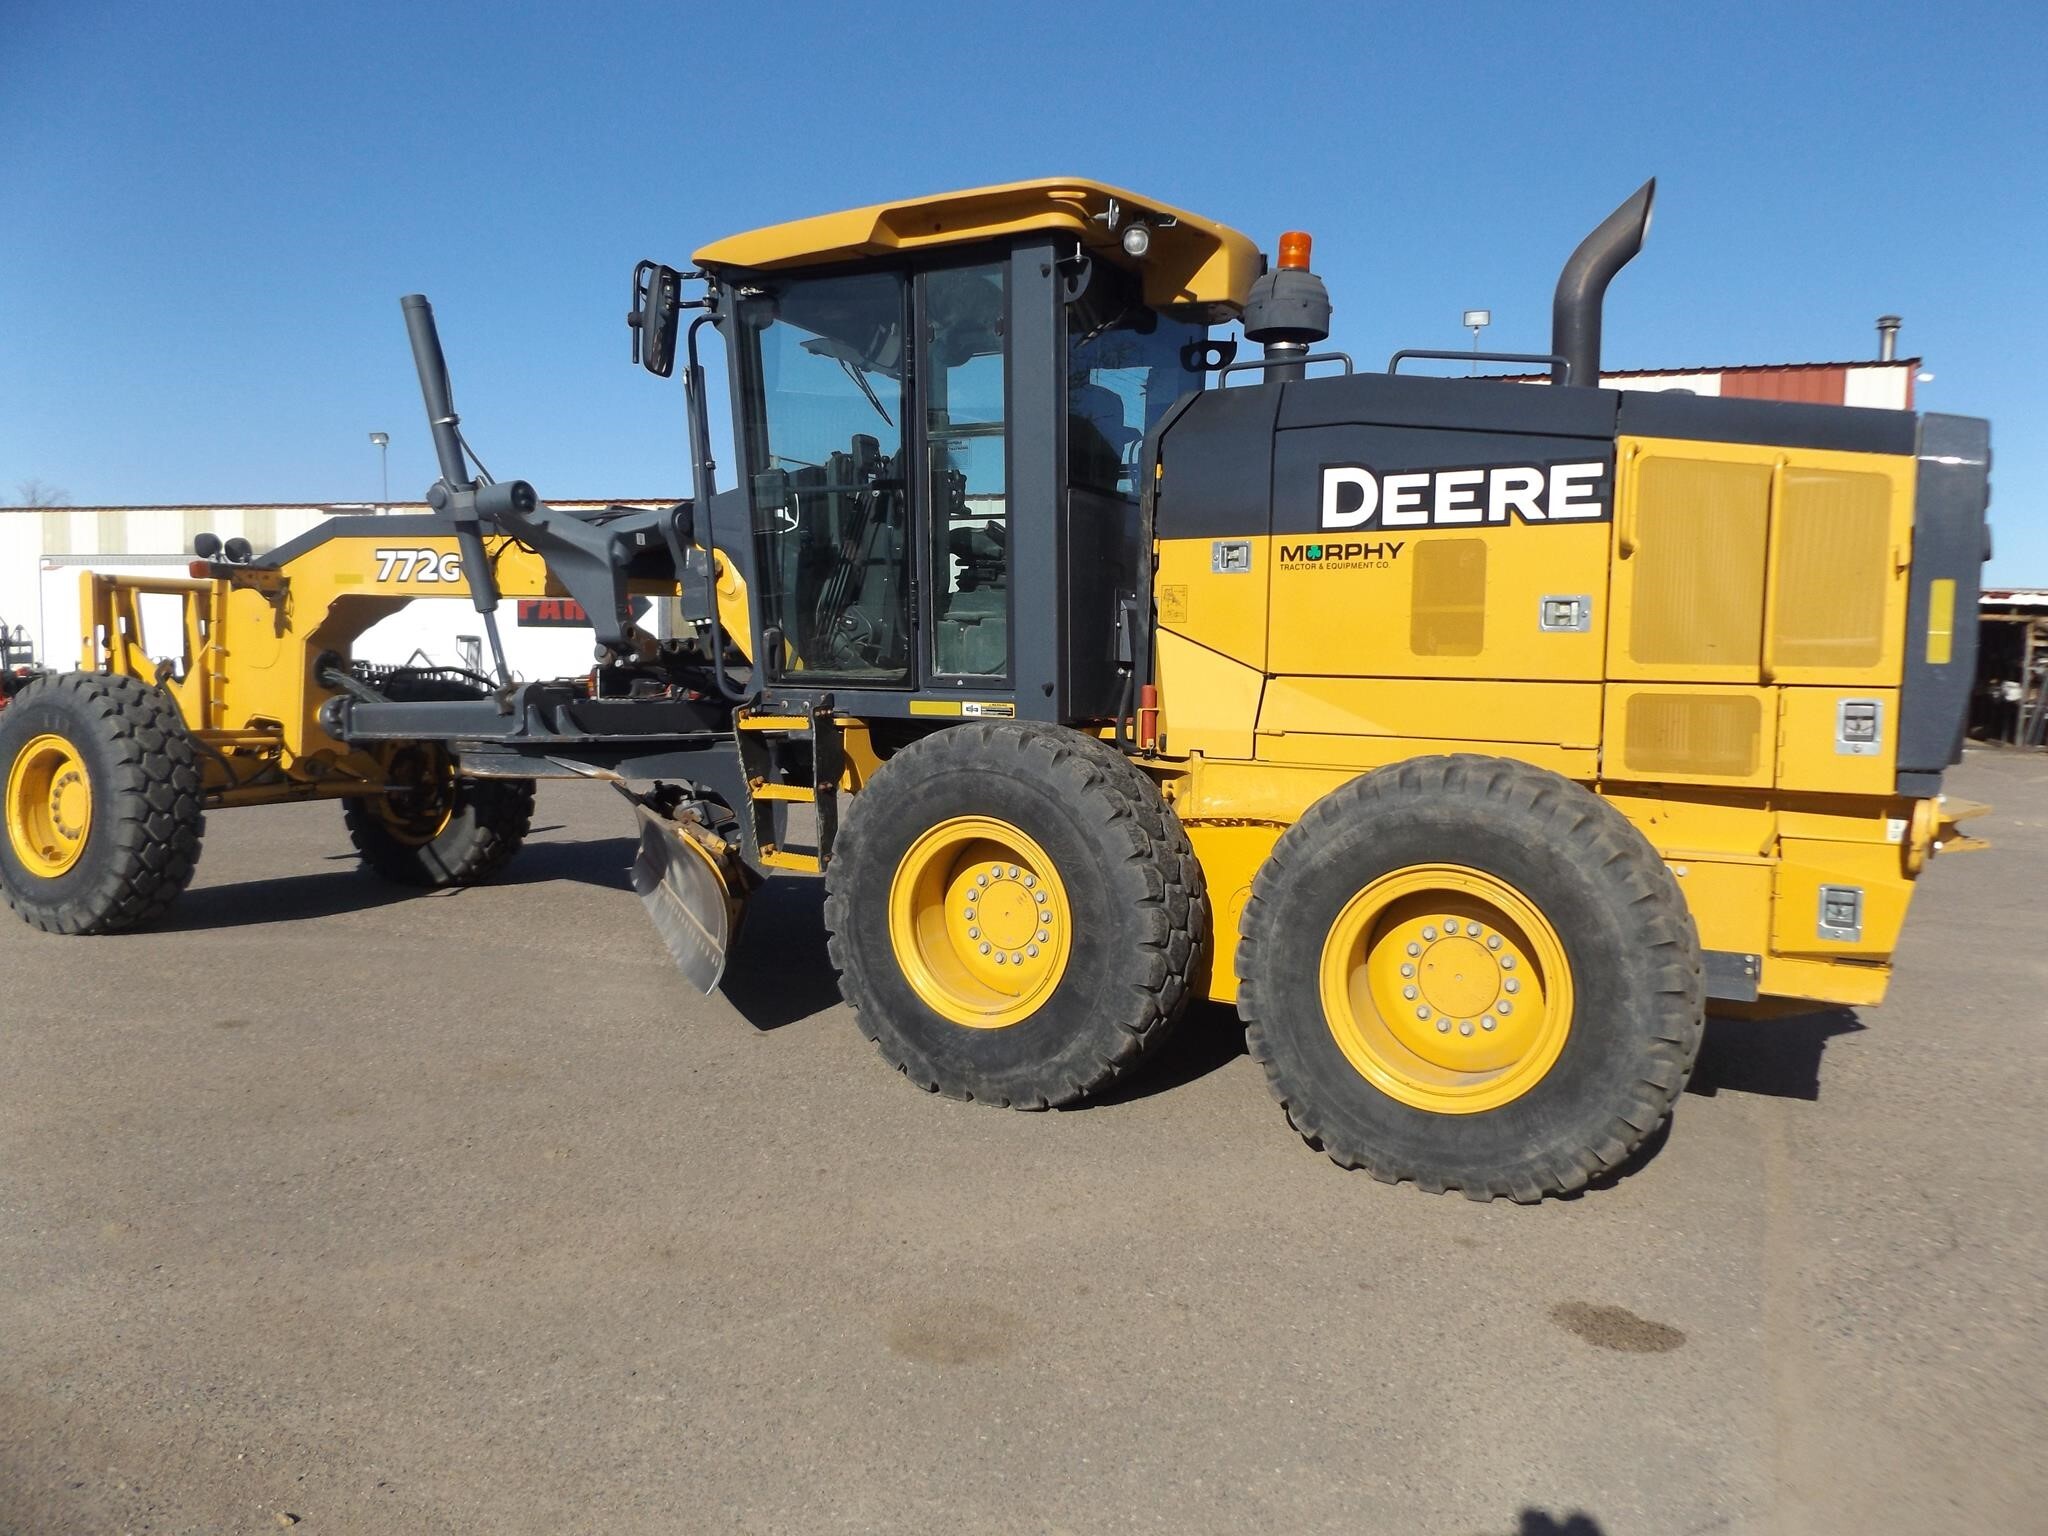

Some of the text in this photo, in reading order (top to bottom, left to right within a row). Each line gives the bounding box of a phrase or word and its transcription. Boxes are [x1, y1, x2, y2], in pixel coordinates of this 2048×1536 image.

[1321, 461, 1604, 529] DEERE
[376, 548, 460, 582] 772G
[1280, 563, 1316, 571] TRACTOR
[1318, 562, 1324, 570] &
[1326, 562, 1374, 570] EQUIPMENT
